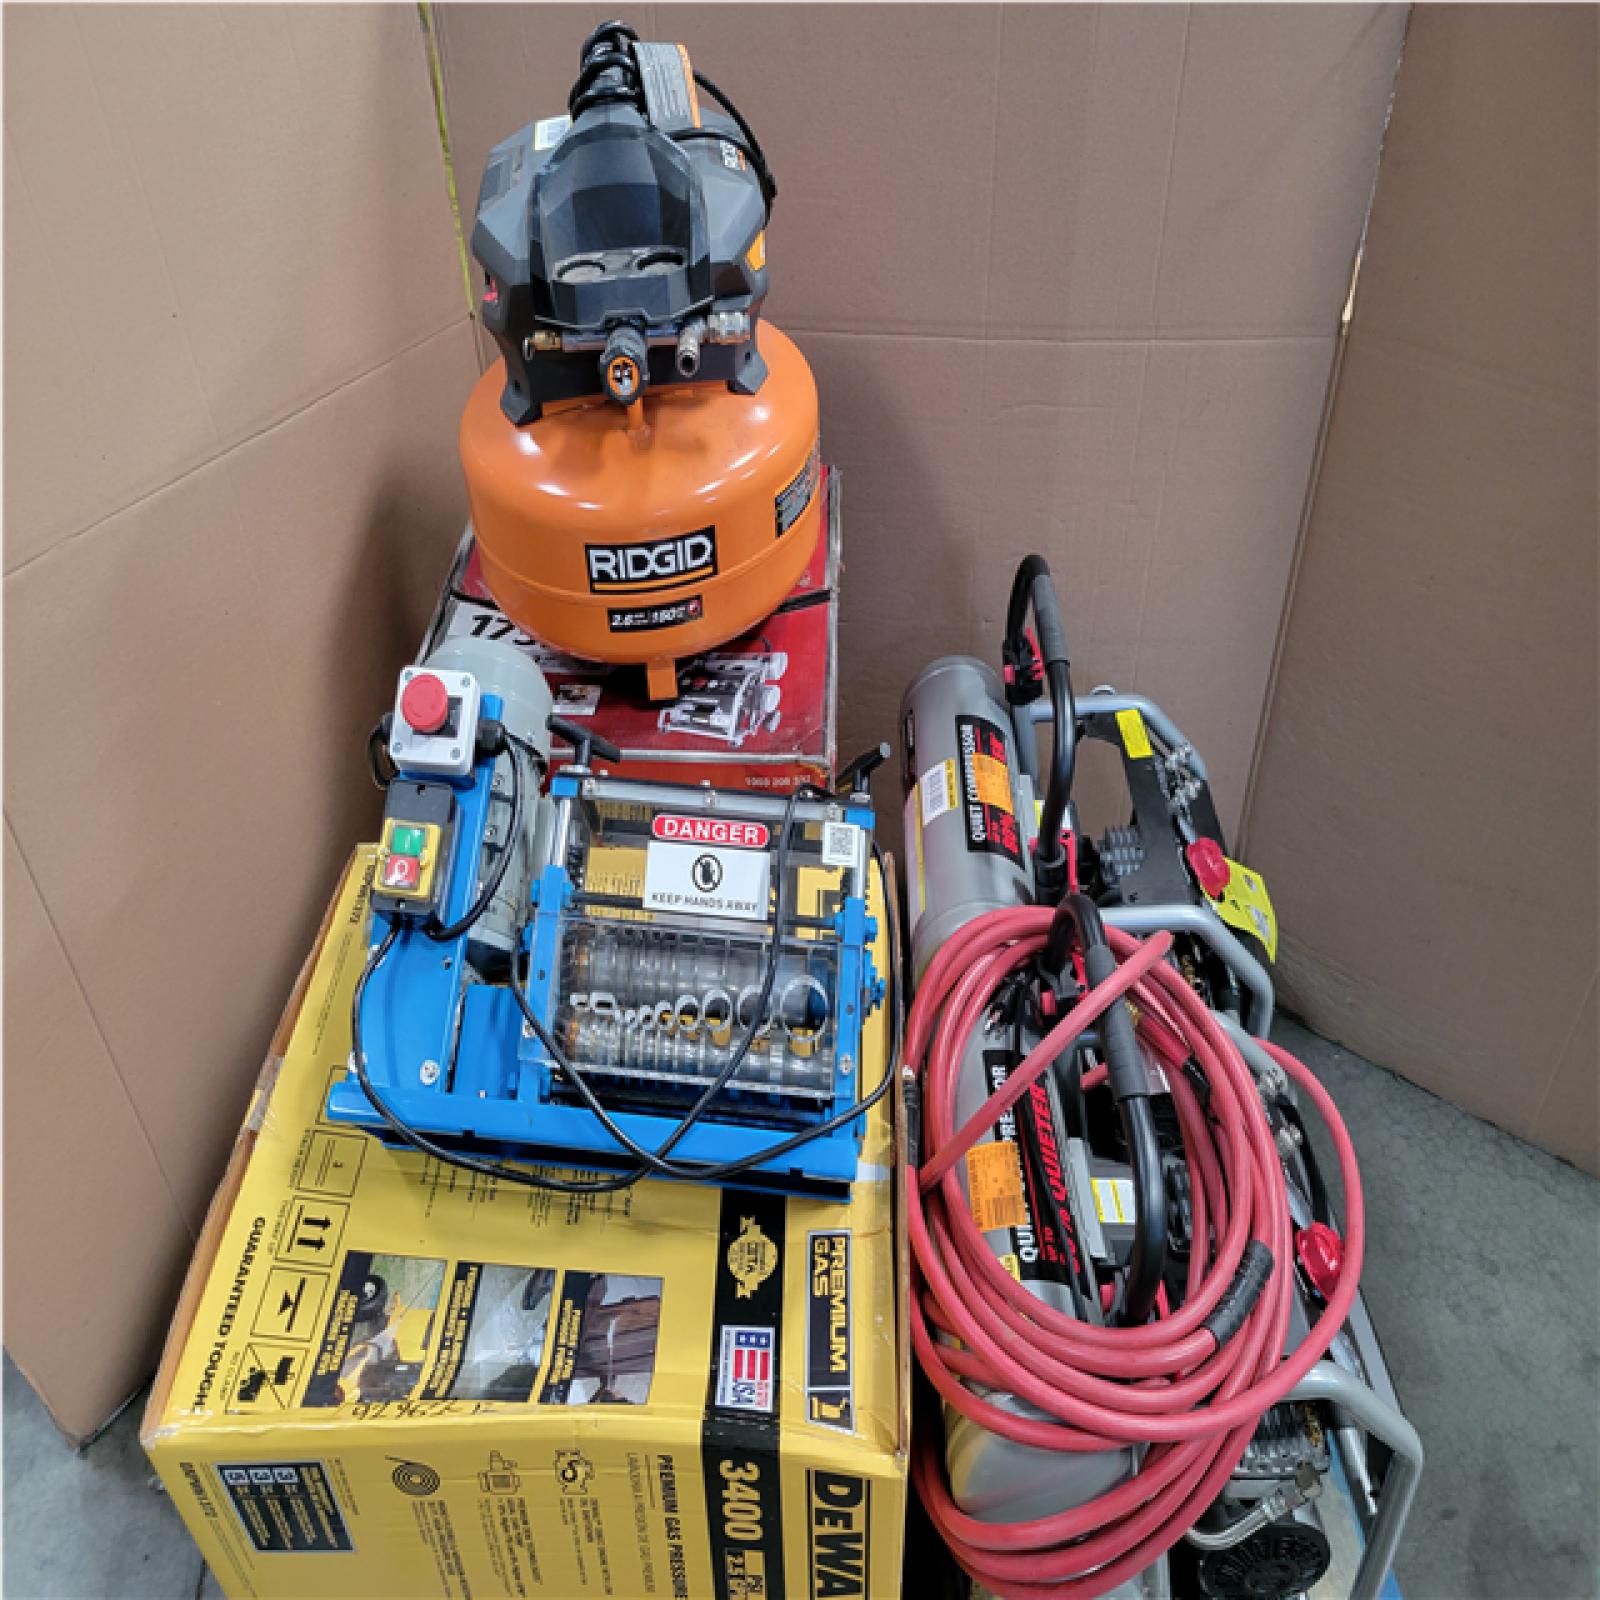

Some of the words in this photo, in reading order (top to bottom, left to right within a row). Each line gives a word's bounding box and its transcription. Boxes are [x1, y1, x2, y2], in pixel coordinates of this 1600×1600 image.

[588, 534, 711, 581] RIDGID
[663, 818, 759, 845] DANGER
[651, 892, 681, 906] KEEP
[683, 895, 723, 911] HANDS
[724, 899, 759, 914] AWAY
[218, 1215, 267, 1336] GUARANTEED
[814, 1237, 830, 1298] GAS
[829, 1236, 847, 1373] PREMIUM
[657, 1454, 678, 1513] PREMIUM
[719, 1459, 764, 1541] 3400
[664, 1517, 681, 1541] GAS
